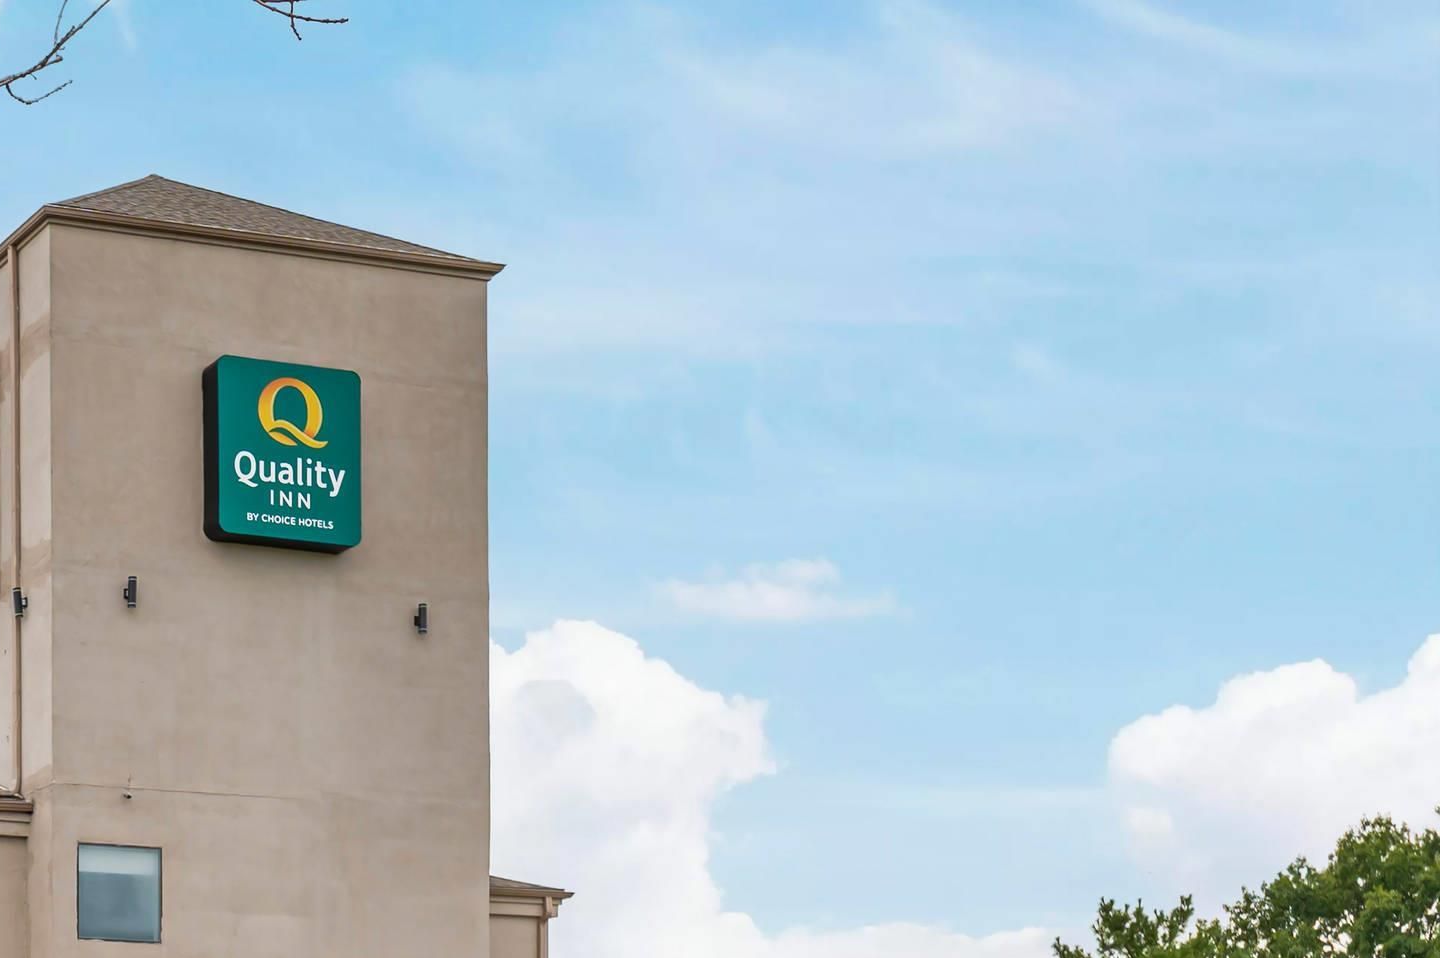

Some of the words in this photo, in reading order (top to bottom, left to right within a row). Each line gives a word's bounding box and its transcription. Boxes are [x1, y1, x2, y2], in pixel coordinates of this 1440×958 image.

[257, 377, 328, 449] Q
[233, 450, 346, 497] Quality
[270, 490, 311, 510] INN
[246, 512, 260, 522] BY
[261, 513, 297, 526] CHOICE
[298, 518, 334, 530] HOTELS
